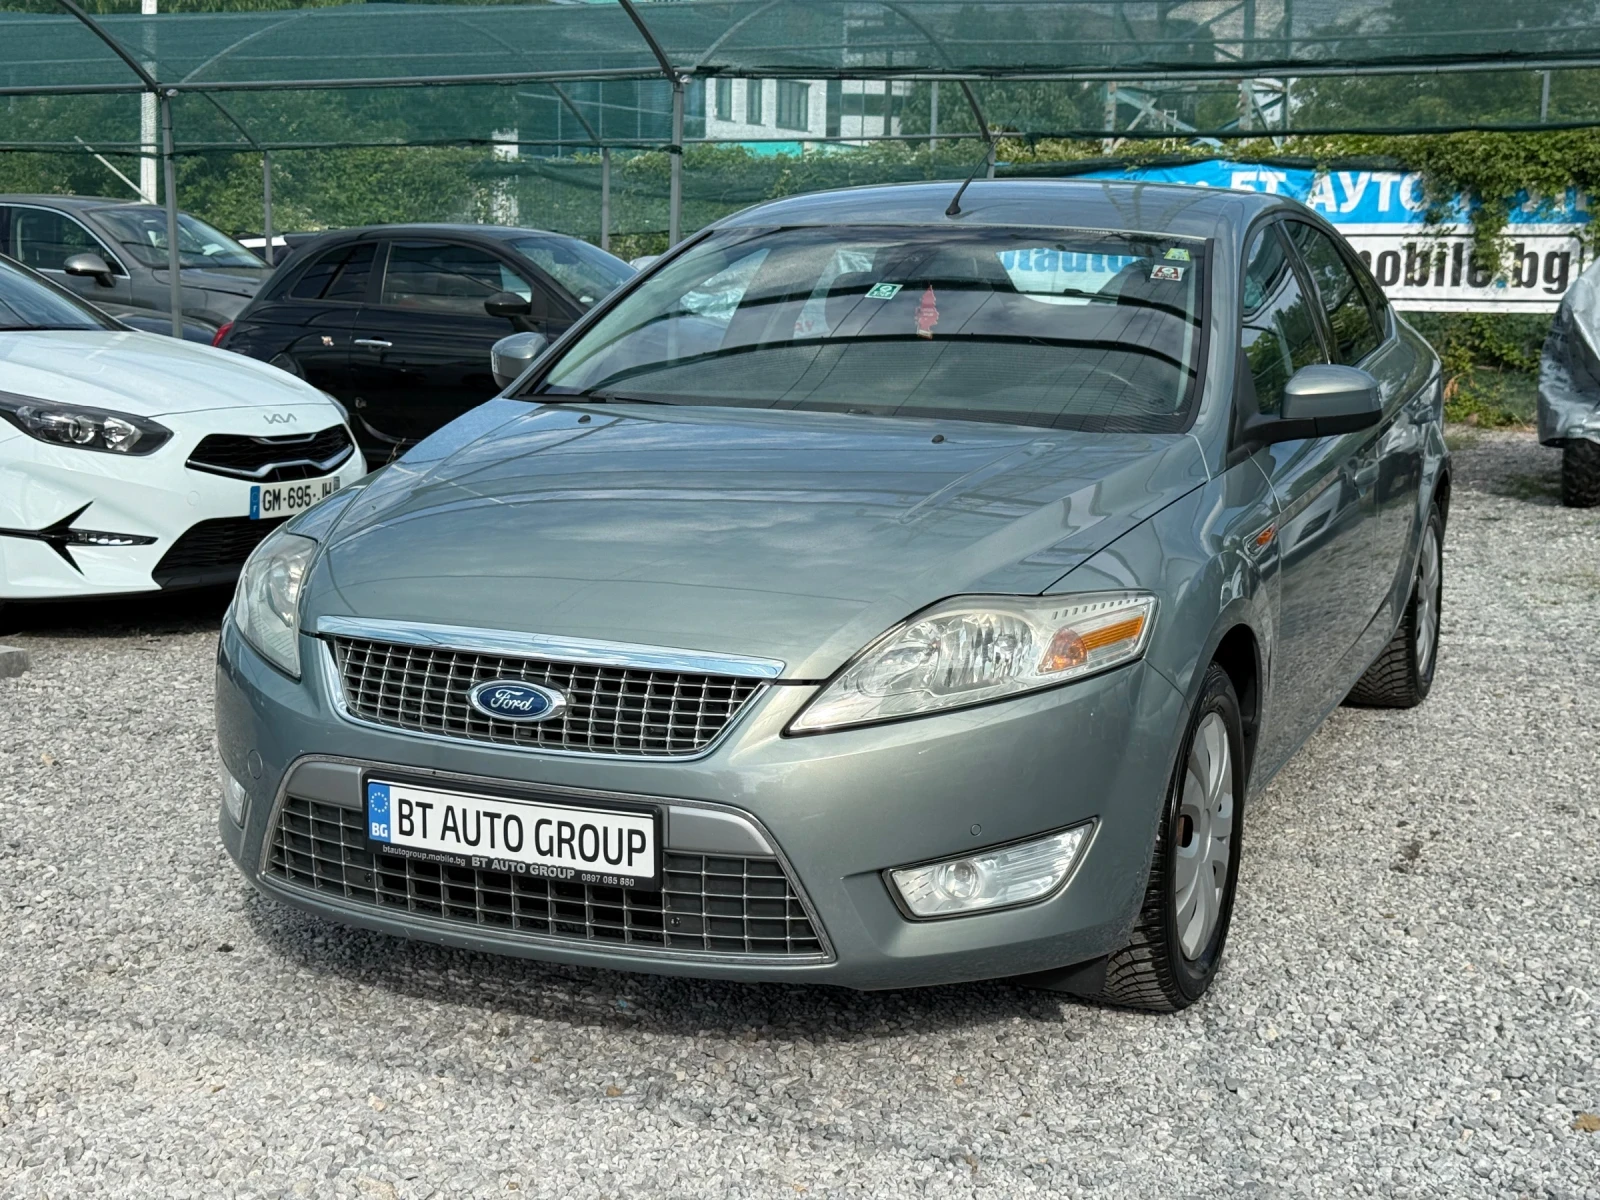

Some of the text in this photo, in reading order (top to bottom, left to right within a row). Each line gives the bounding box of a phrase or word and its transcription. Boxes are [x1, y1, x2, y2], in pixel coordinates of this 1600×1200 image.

[490, 689, 532, 711] Ford
[371, 823, 388, 838] BG
[398, 798, 647, 867] BT AUTO GROUP
[382, 844, 466, 865] btautogroup.mobile.bg
[471, 856, 488, 868] BT
[491, 859, 526, 873] AUTO
[530, 864, 575, 880] GROUP
[581, 873, 601, 883] 0897
